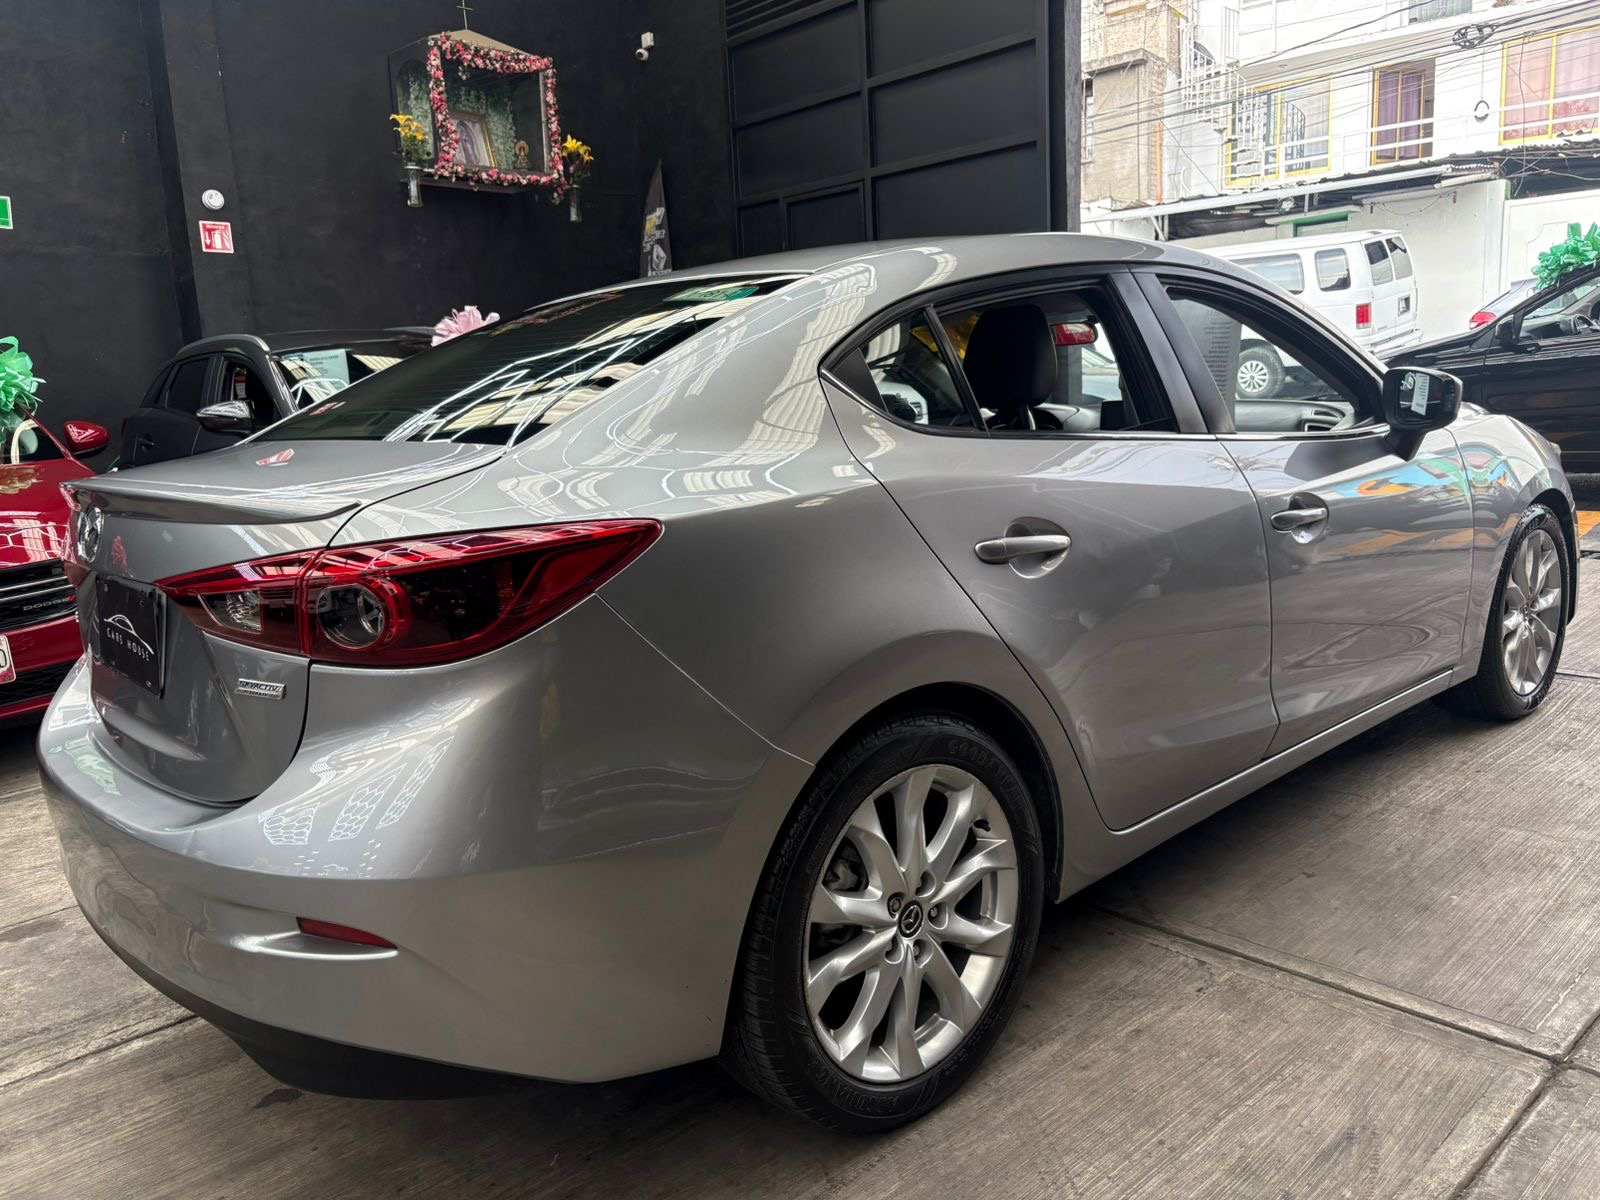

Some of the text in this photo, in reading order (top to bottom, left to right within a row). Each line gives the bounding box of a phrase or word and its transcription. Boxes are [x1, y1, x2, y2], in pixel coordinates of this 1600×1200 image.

[24, 599, 68, 610] DODGE
[106, 628, 150, 661] CARS HOUSE
